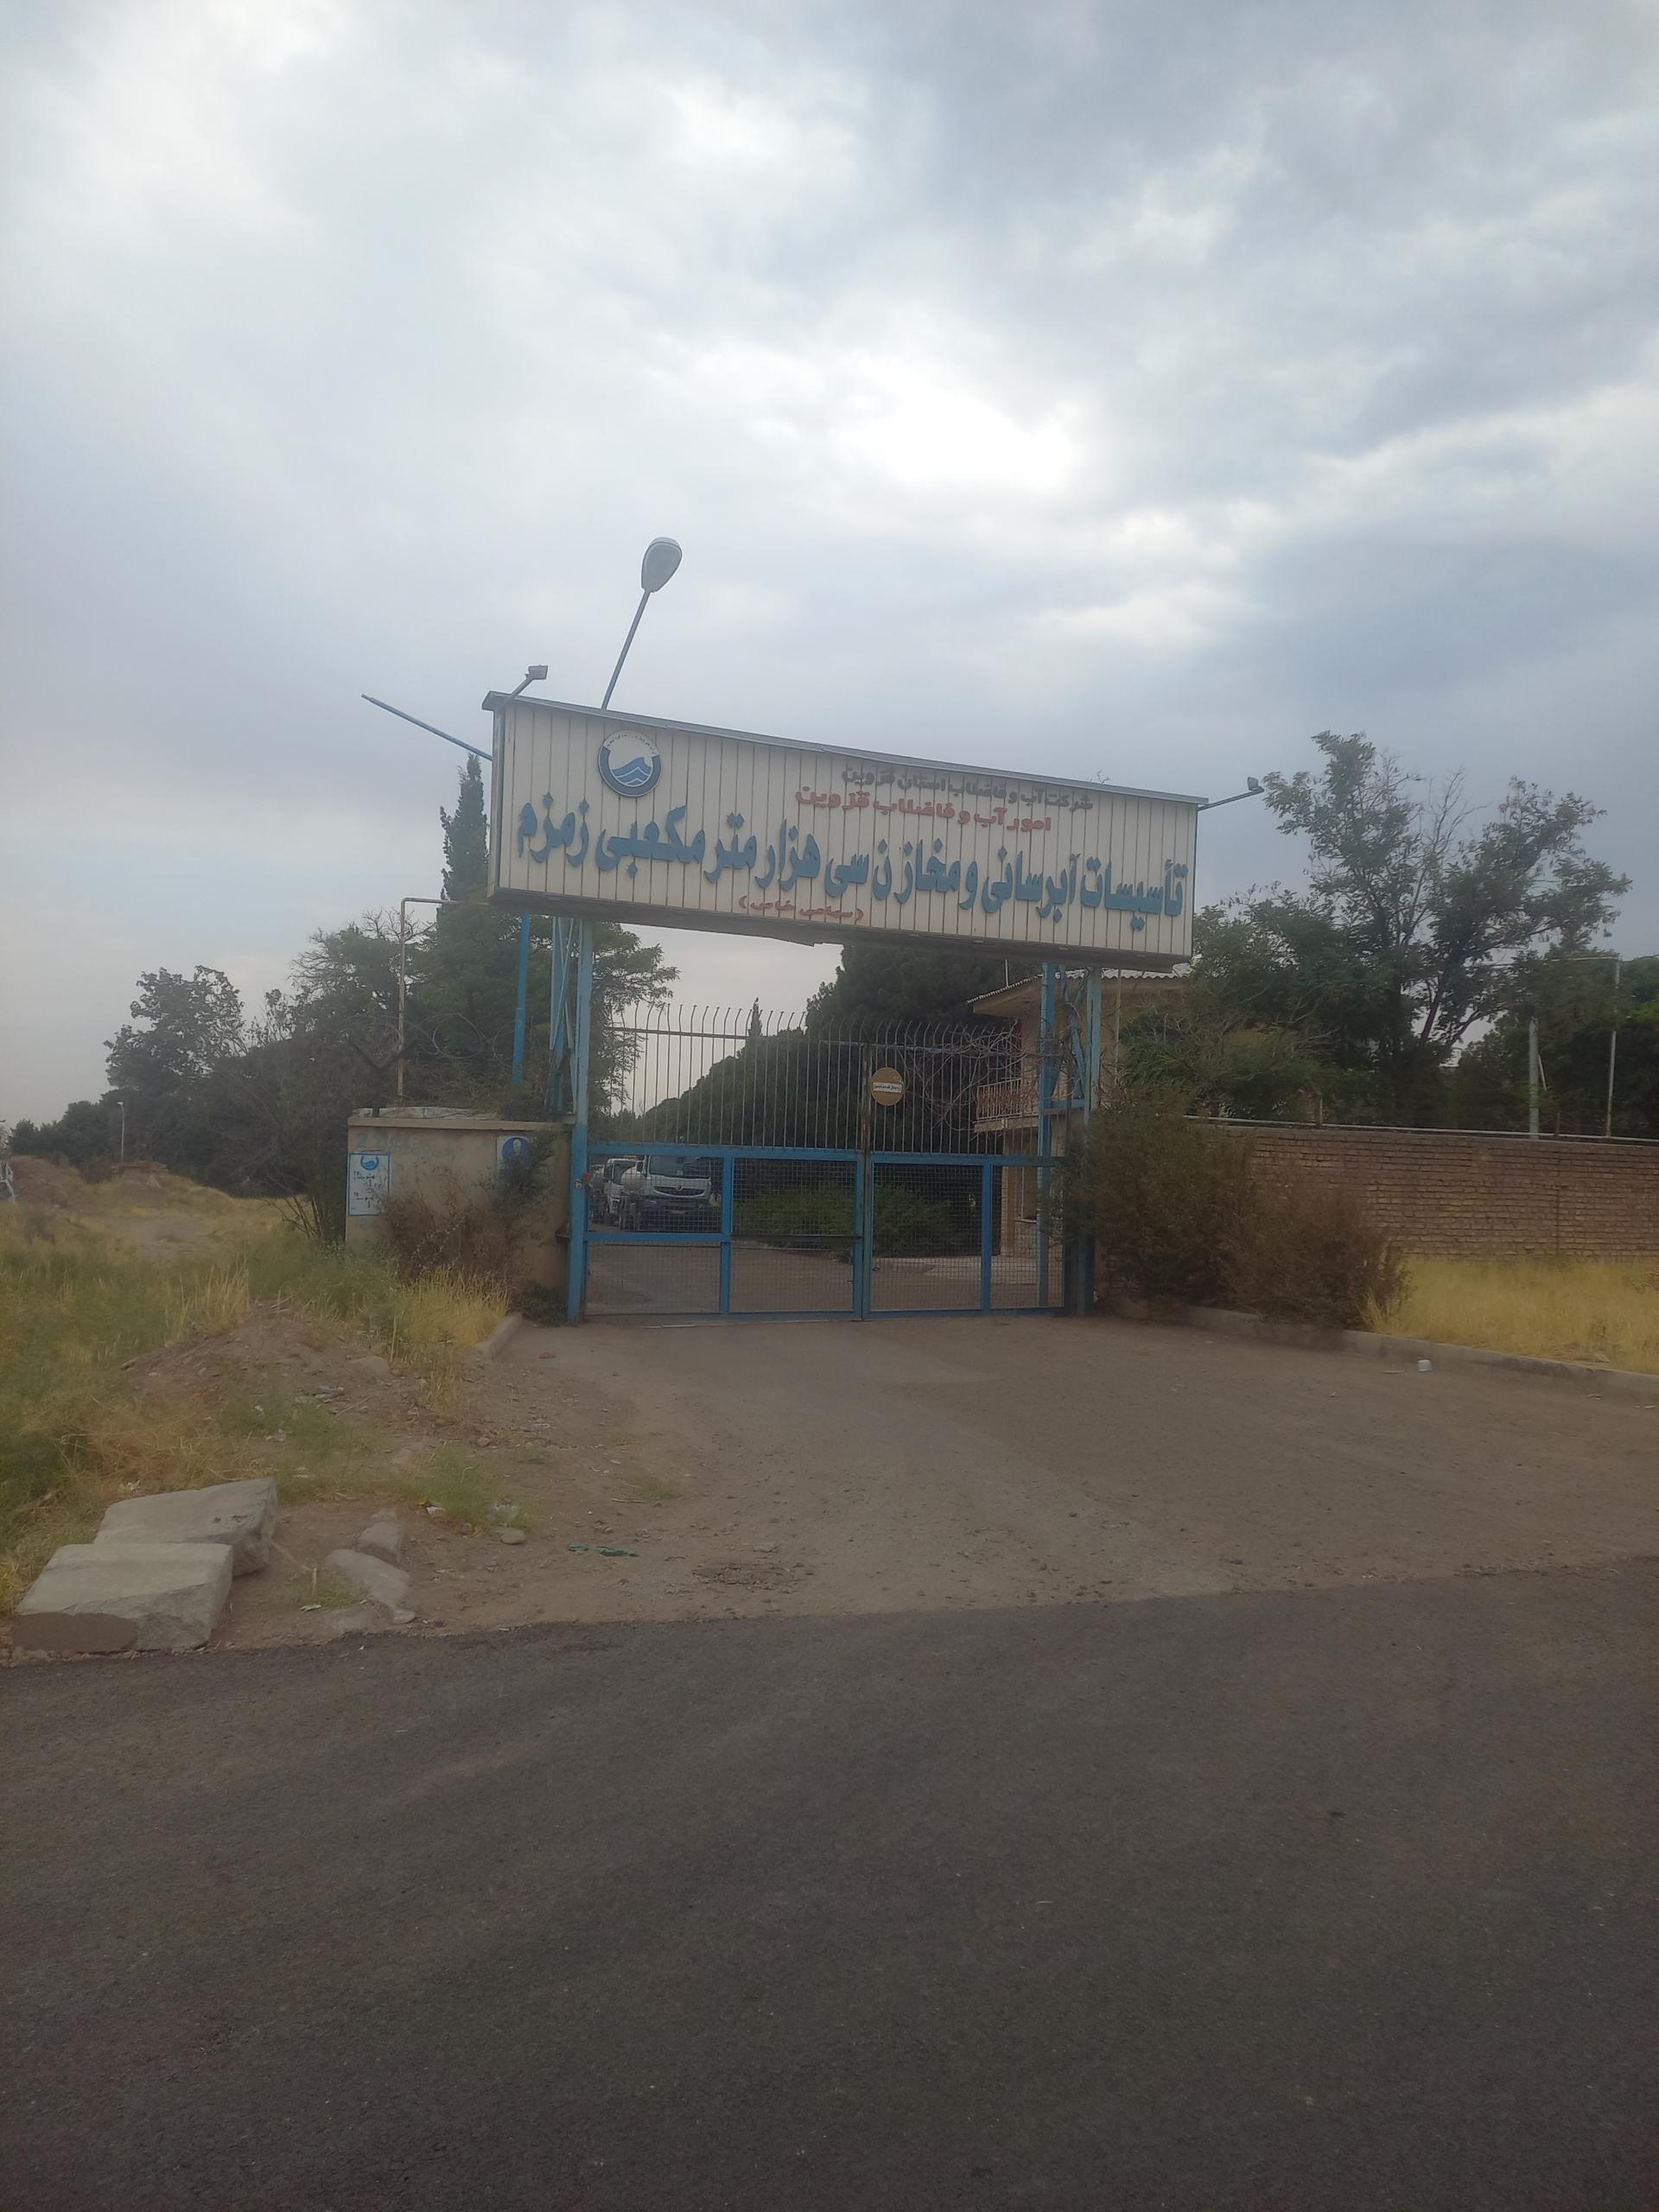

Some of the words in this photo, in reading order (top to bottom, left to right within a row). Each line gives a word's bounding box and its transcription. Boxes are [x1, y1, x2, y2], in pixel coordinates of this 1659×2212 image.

[842, 767, 896, 786] قزوین
[897, 774, 946, 791] استان
[795, 786, 870, 810] قزوین
[1007, 791, 1018, 804] و
[1020, 785, 1046, 806] آب
[1045, 793, 1094, 812] شرکت
[873, 798, 956, 819] فاضلاب
[957, 810, 970, 825] و
[974, 807, 1007, 828] آب
[517, 791, 590, 868] زمزم
[1007, 817, 1052, 832] امور
[594, 804, 706, 880] مکعبی
[703, 811, 758, 884] متر
[754, 818, 821, 892] هزار
[824, 854, 870, 898] سی
[871, 837, 961, 905] مخازن
[957, 861, 978, 910] و
